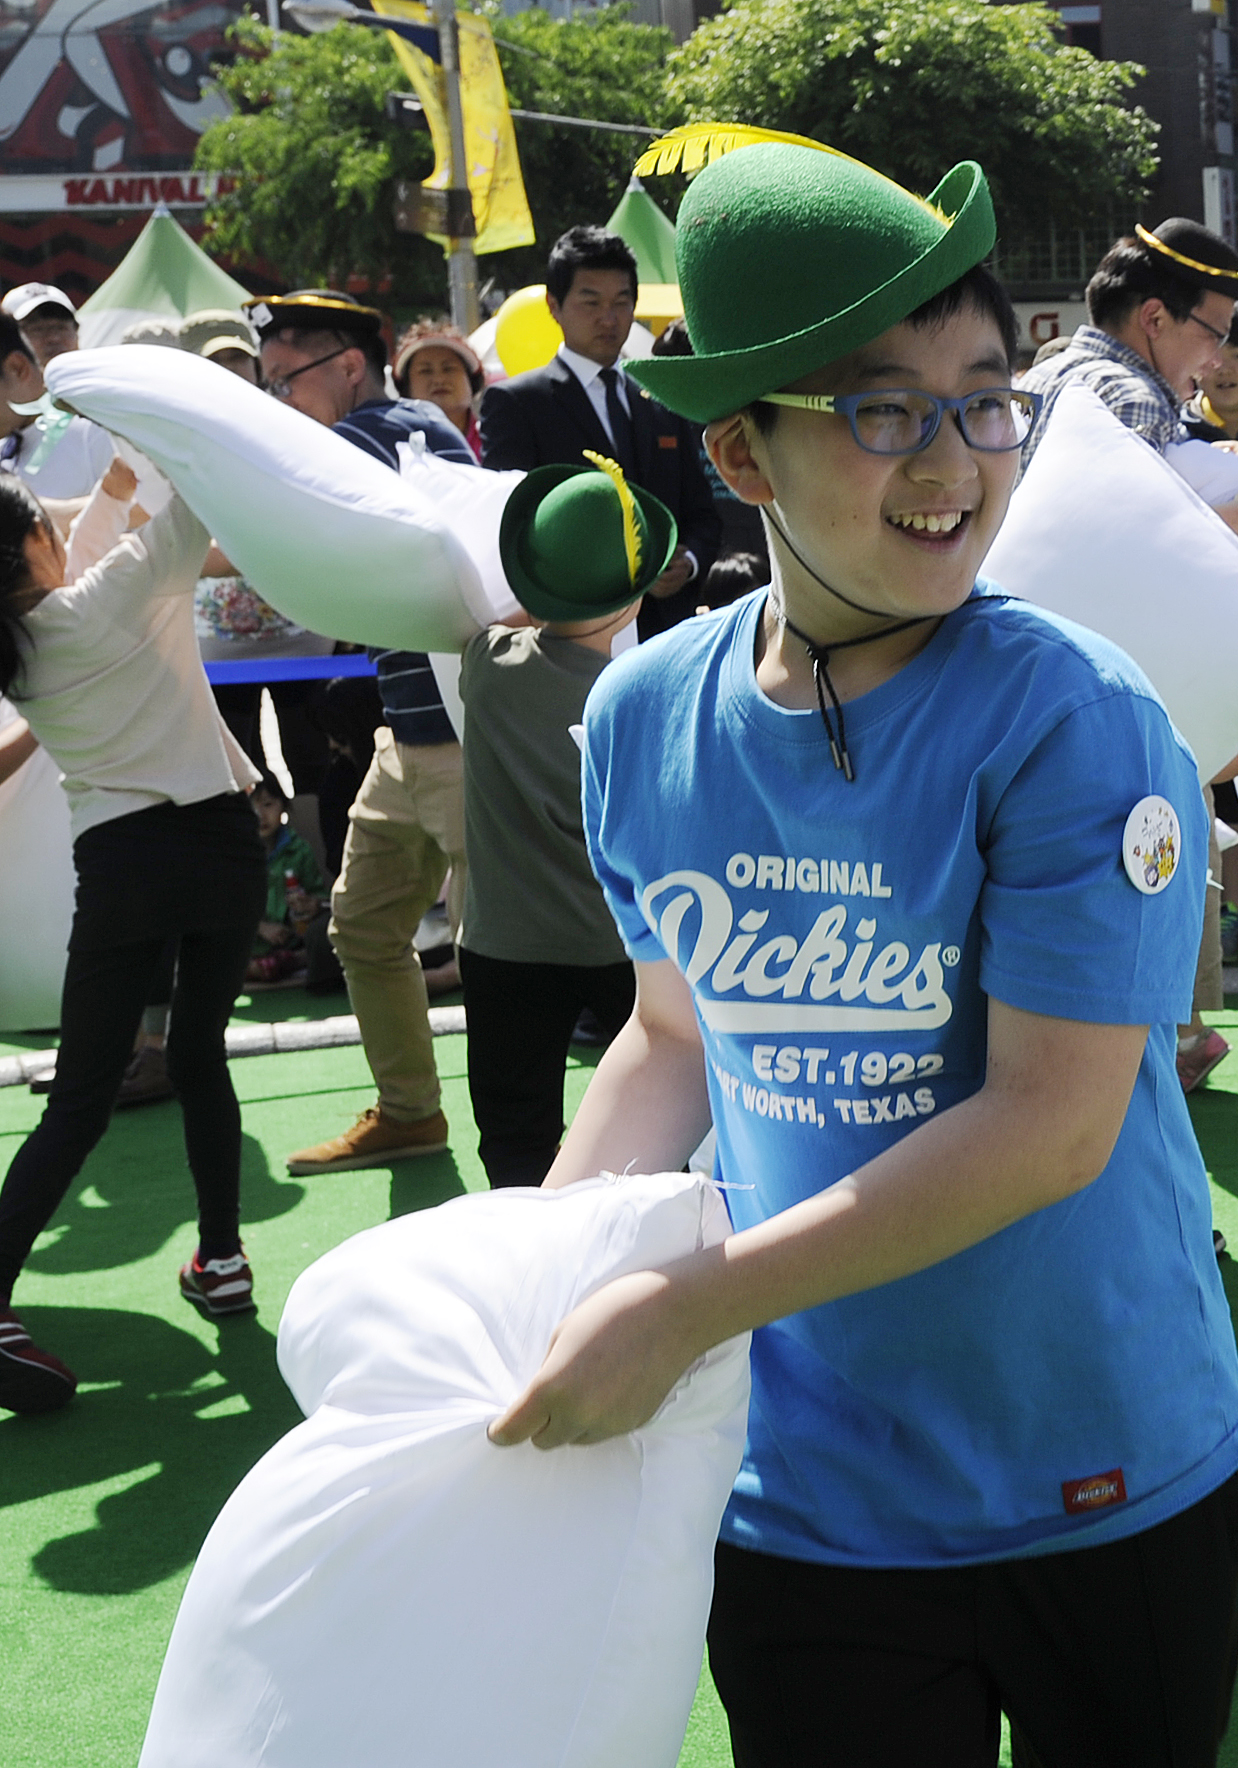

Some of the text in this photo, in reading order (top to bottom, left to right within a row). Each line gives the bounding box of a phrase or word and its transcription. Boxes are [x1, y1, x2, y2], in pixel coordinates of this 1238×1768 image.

[726, 852, 893, 898] ORIGINAL
[752, 1044, 945, 1087] EST.1922
[742, 1082, 826, 1129] WORTH,
[834, 1086, 936, 1125] TEXAS
